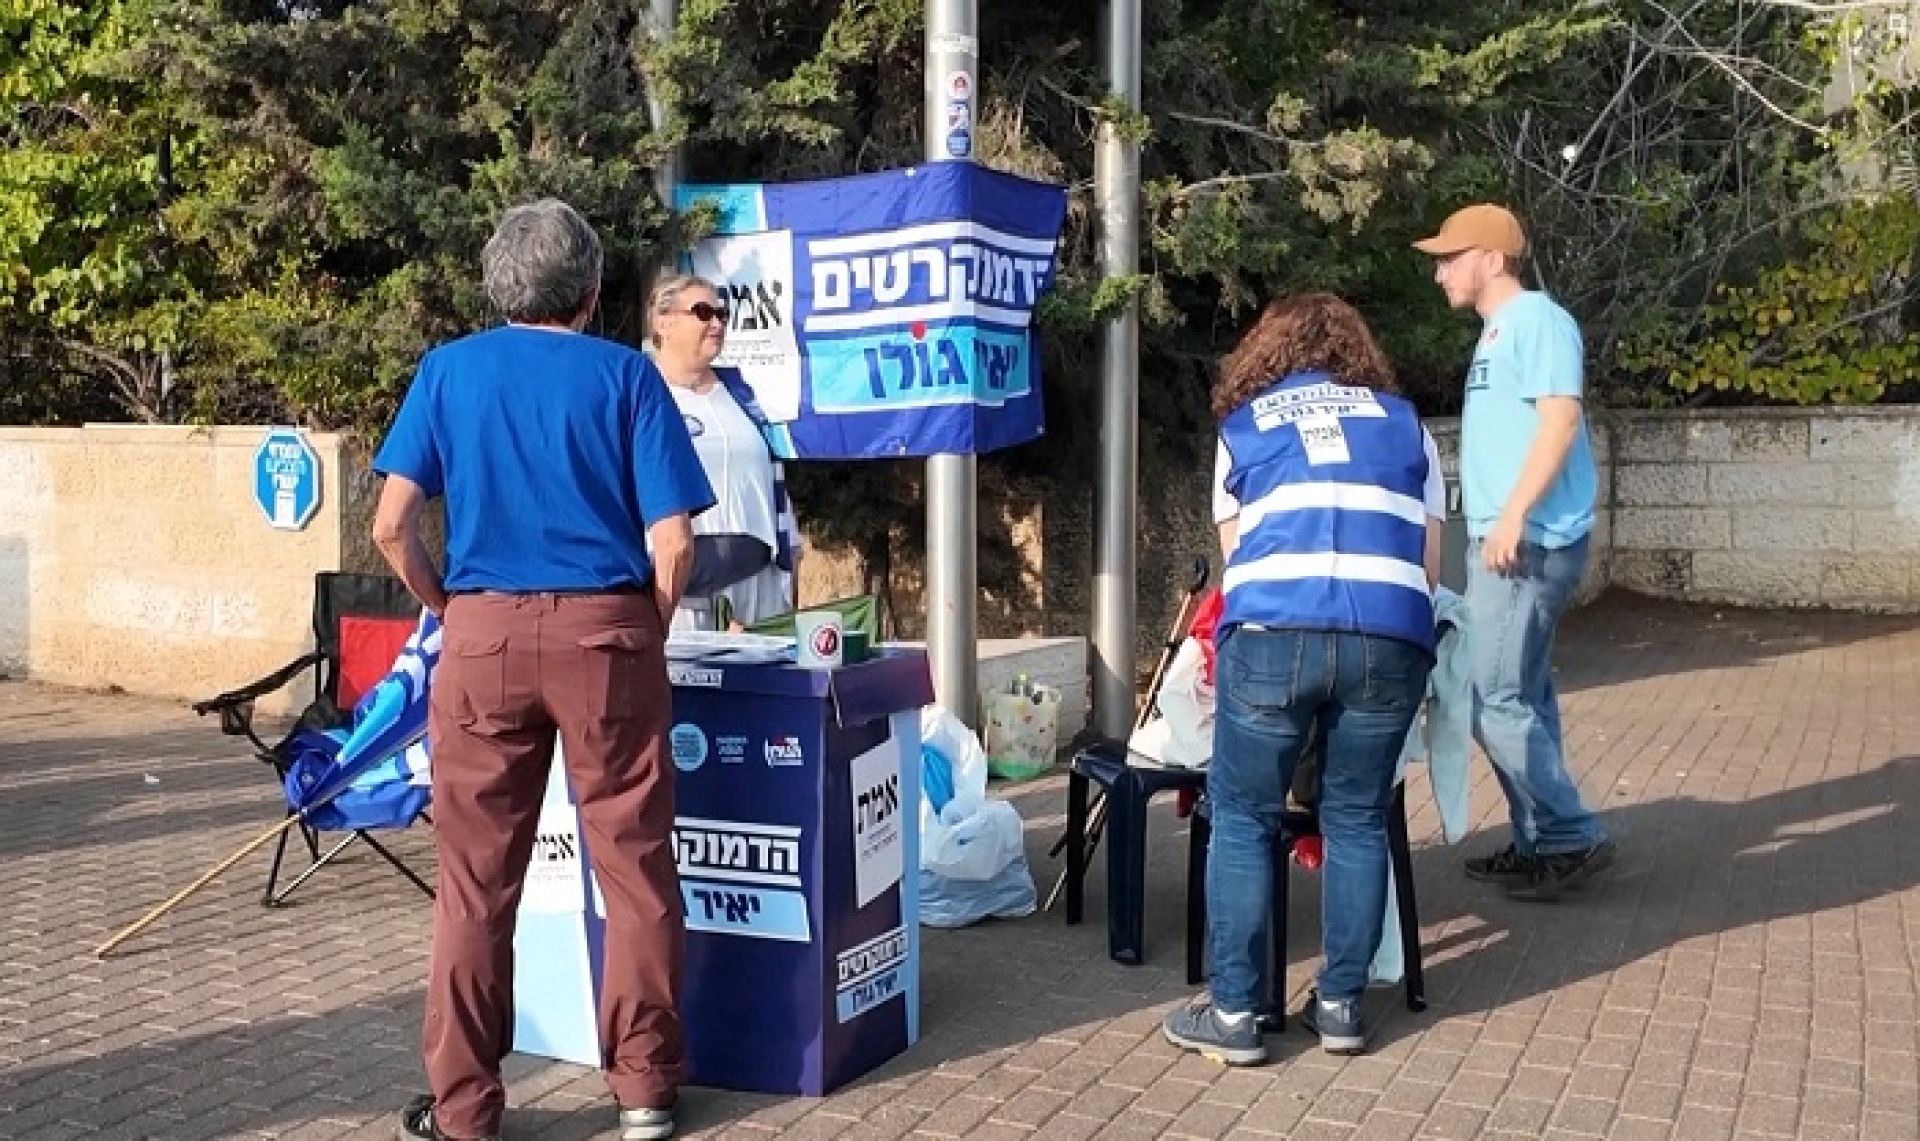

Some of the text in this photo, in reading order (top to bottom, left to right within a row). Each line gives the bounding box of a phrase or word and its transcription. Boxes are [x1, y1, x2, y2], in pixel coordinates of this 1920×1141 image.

[717, 280, 783, 332] אמ
[863, 339, 969, 399] גולן
[858, 773, 898, 835] אמת
[533, 833, 576, 862] אמ
[671, 830, 799, 873] הדמוק
[691, 889, 761, 924] יאיר
